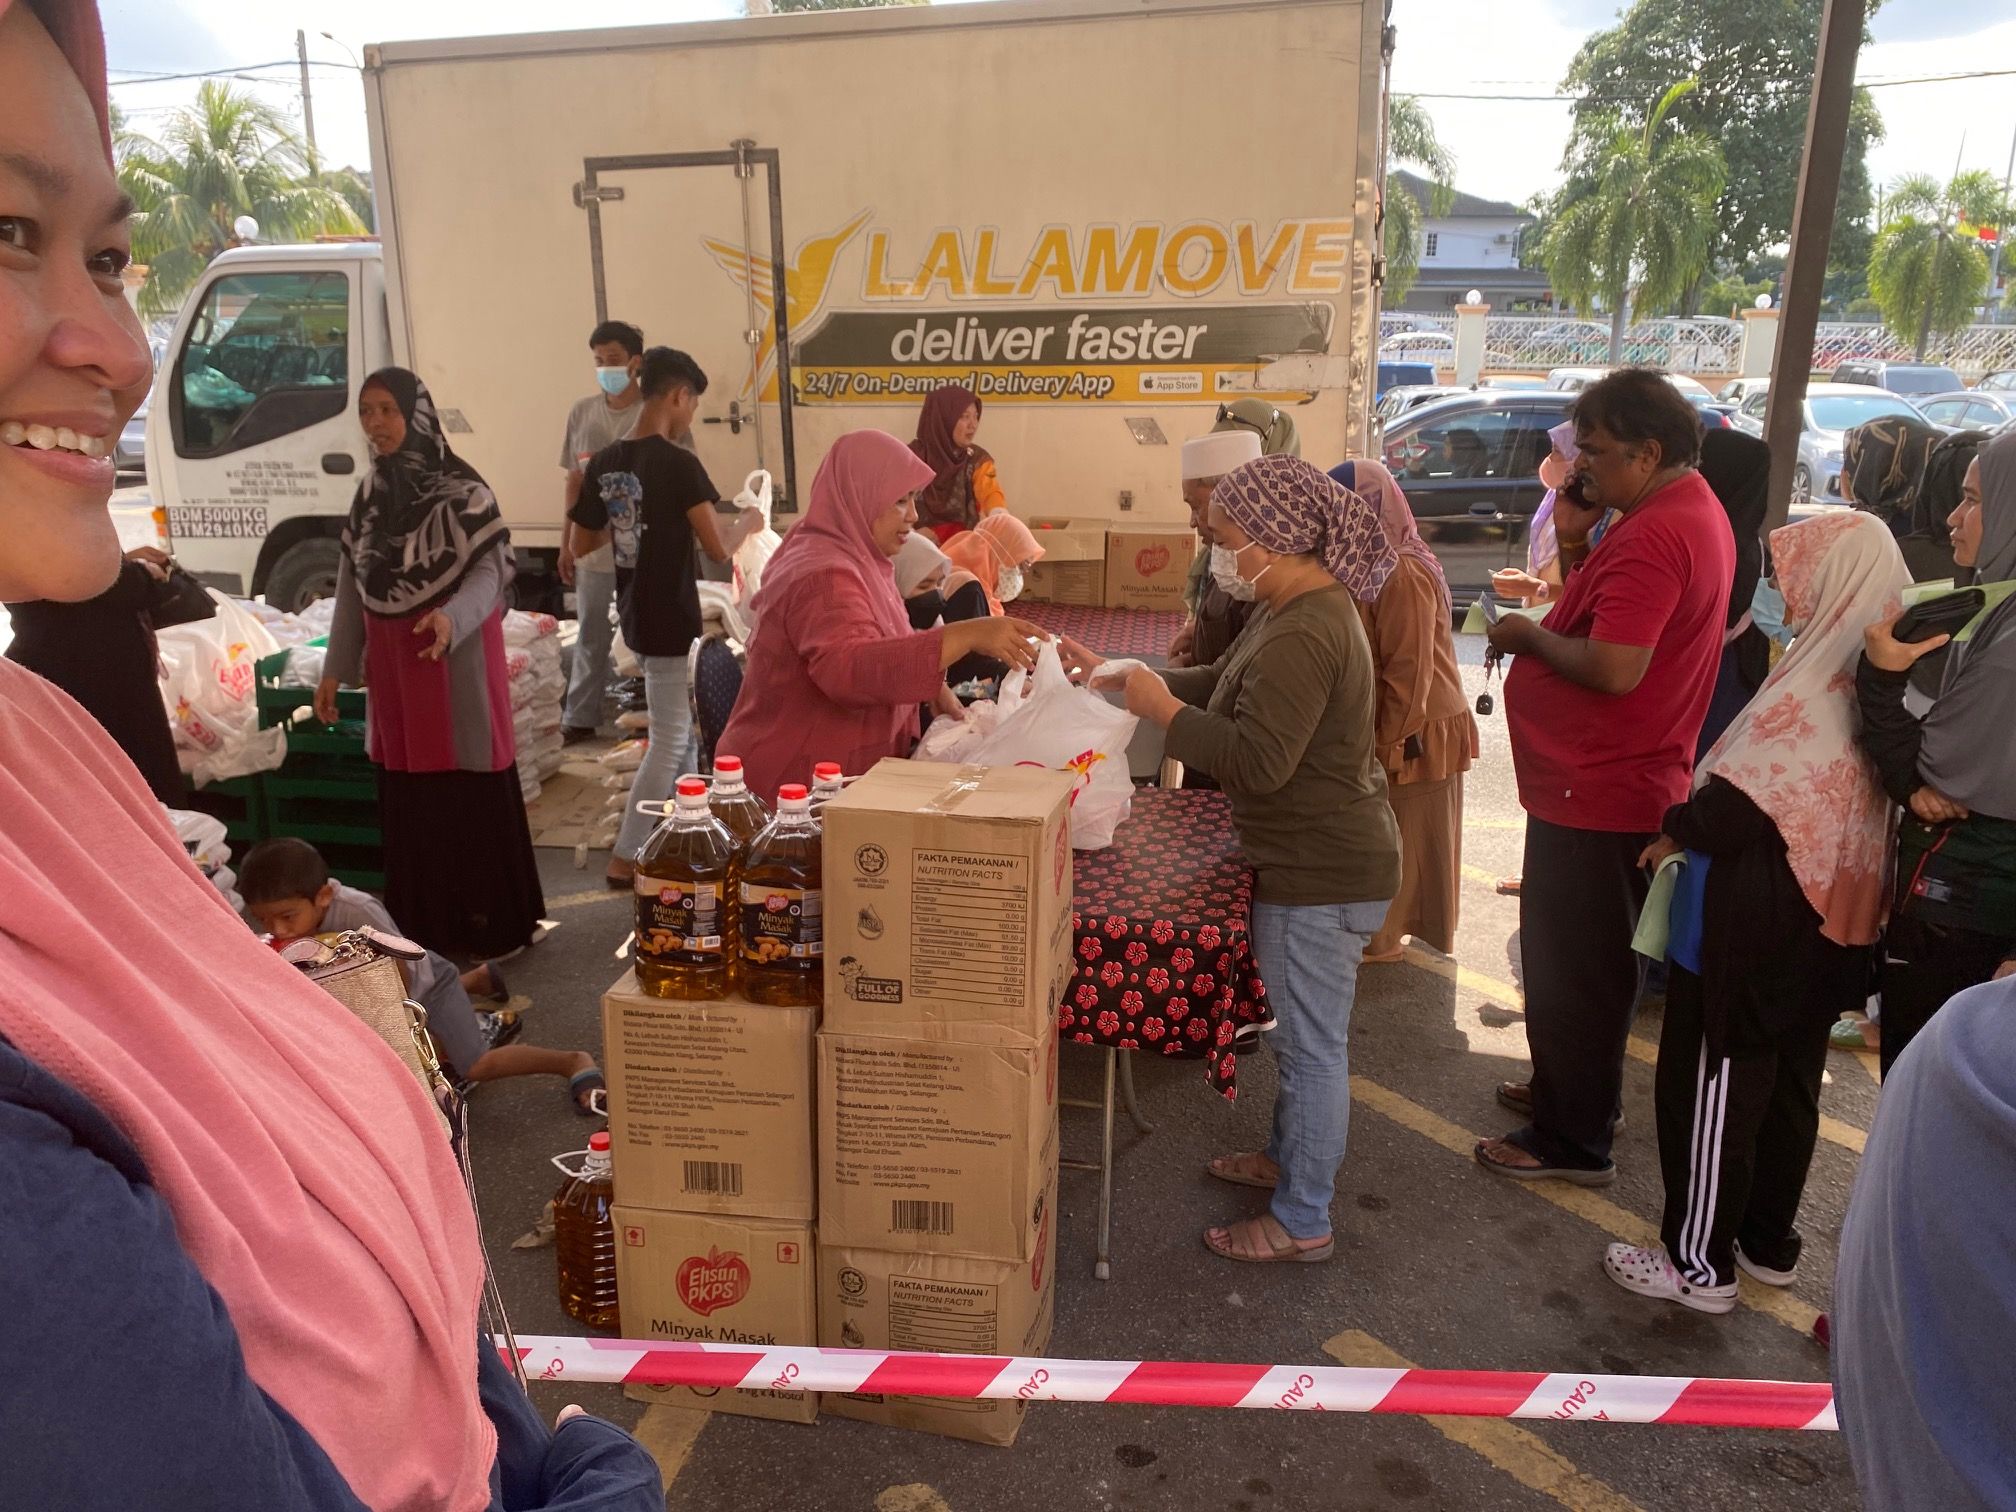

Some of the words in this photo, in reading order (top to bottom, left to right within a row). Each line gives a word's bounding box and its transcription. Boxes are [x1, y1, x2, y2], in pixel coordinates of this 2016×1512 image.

[865, 222, 1351, 296] LALAMOVE
[891, 317, 1054, 362] deliver
[1066, 314, 1207, 361] faster
[805, 372, 850, 397] 24/7
[979, 371, 1069, 399] Delivery
[1066, 372, 1114, 399] App
[1156, 380, 1174, 392] App
[1175, 380, 1198, 390] Store
[918, 854, 949, 863] FAKTA
[951, 856, 1013, 867] PEMAKANAN
[918, 866, 970, 877] NUTRITION
[972, 869, 1004, 880] FACTS
[652, 904, 688, 918] Minyak
[758, 911, 795, 924] Minyak
[654, 913, 684, 926] Masak
[760, 921, 793, 933] Masak
[858, 983, 883, 994] FULL
[884, 985, 900, 994] OF
[858, 992, 900, 1002] GOODNESS
[689, 1266, 738, 1288] Ehsan
[688, 1282, 733, 1306] PKPS
[893, 1280, 923, 1291] FAKTA
[925, 1283, 983, 1297] PEMAKANAN
[893, 1291, 943, 1304] NUTRITION
[944, 1296, 975, 1307] FACTS
[651, 1319, 713, 1340] Minyak
[720, 1328, 775, 1346] Masak
